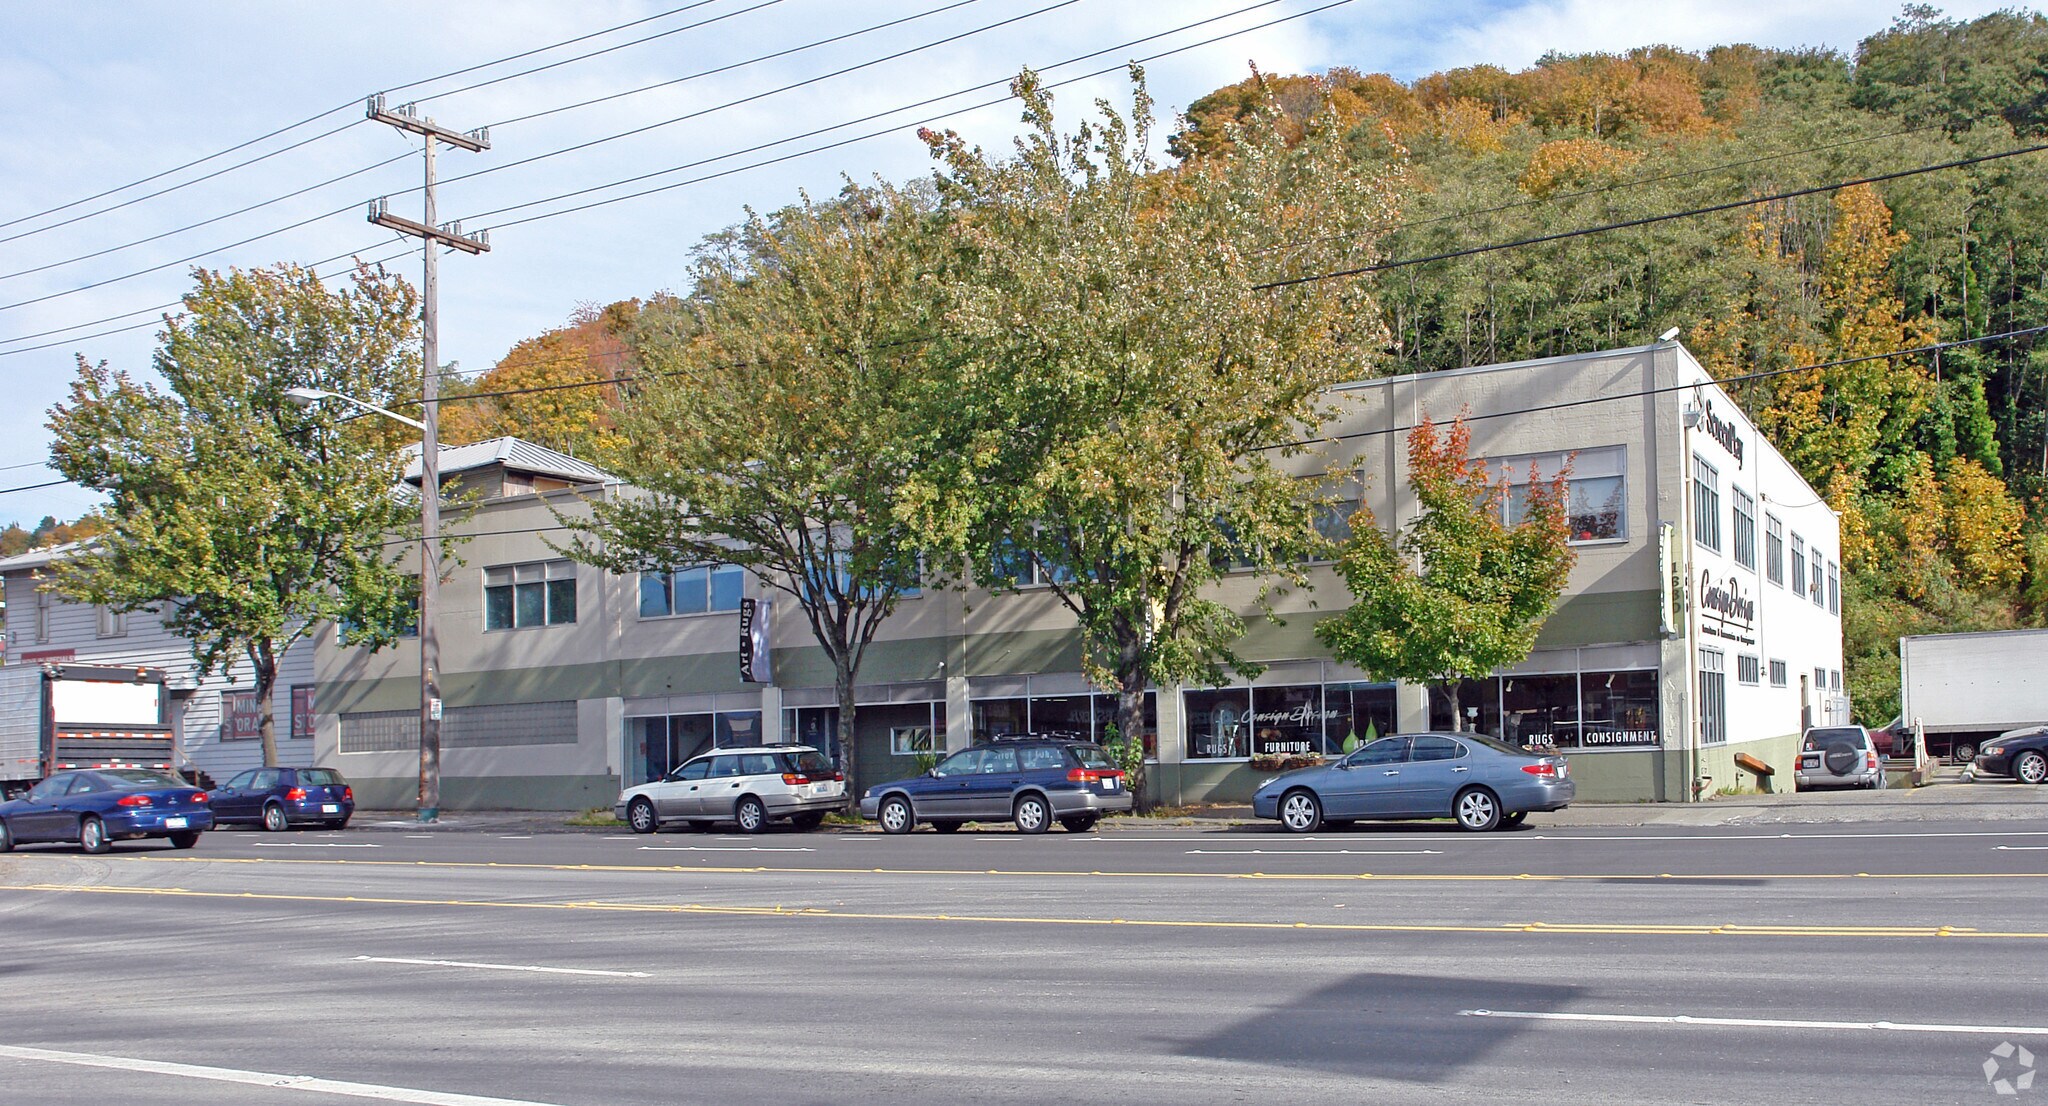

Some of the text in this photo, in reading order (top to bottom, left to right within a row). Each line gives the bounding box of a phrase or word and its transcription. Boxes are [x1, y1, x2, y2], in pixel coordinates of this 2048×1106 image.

[741, 601, 752, 675] Art Rugs
[236, 698, 258, 714] MIN
[1528, 733, 1554, 745] RUGS
[1586, 730, 1655, 744] CONSIGNMENT
[1206, 744, 1228, 754] RUGS
[1264, 741, 1311, 752] FURNITURE
